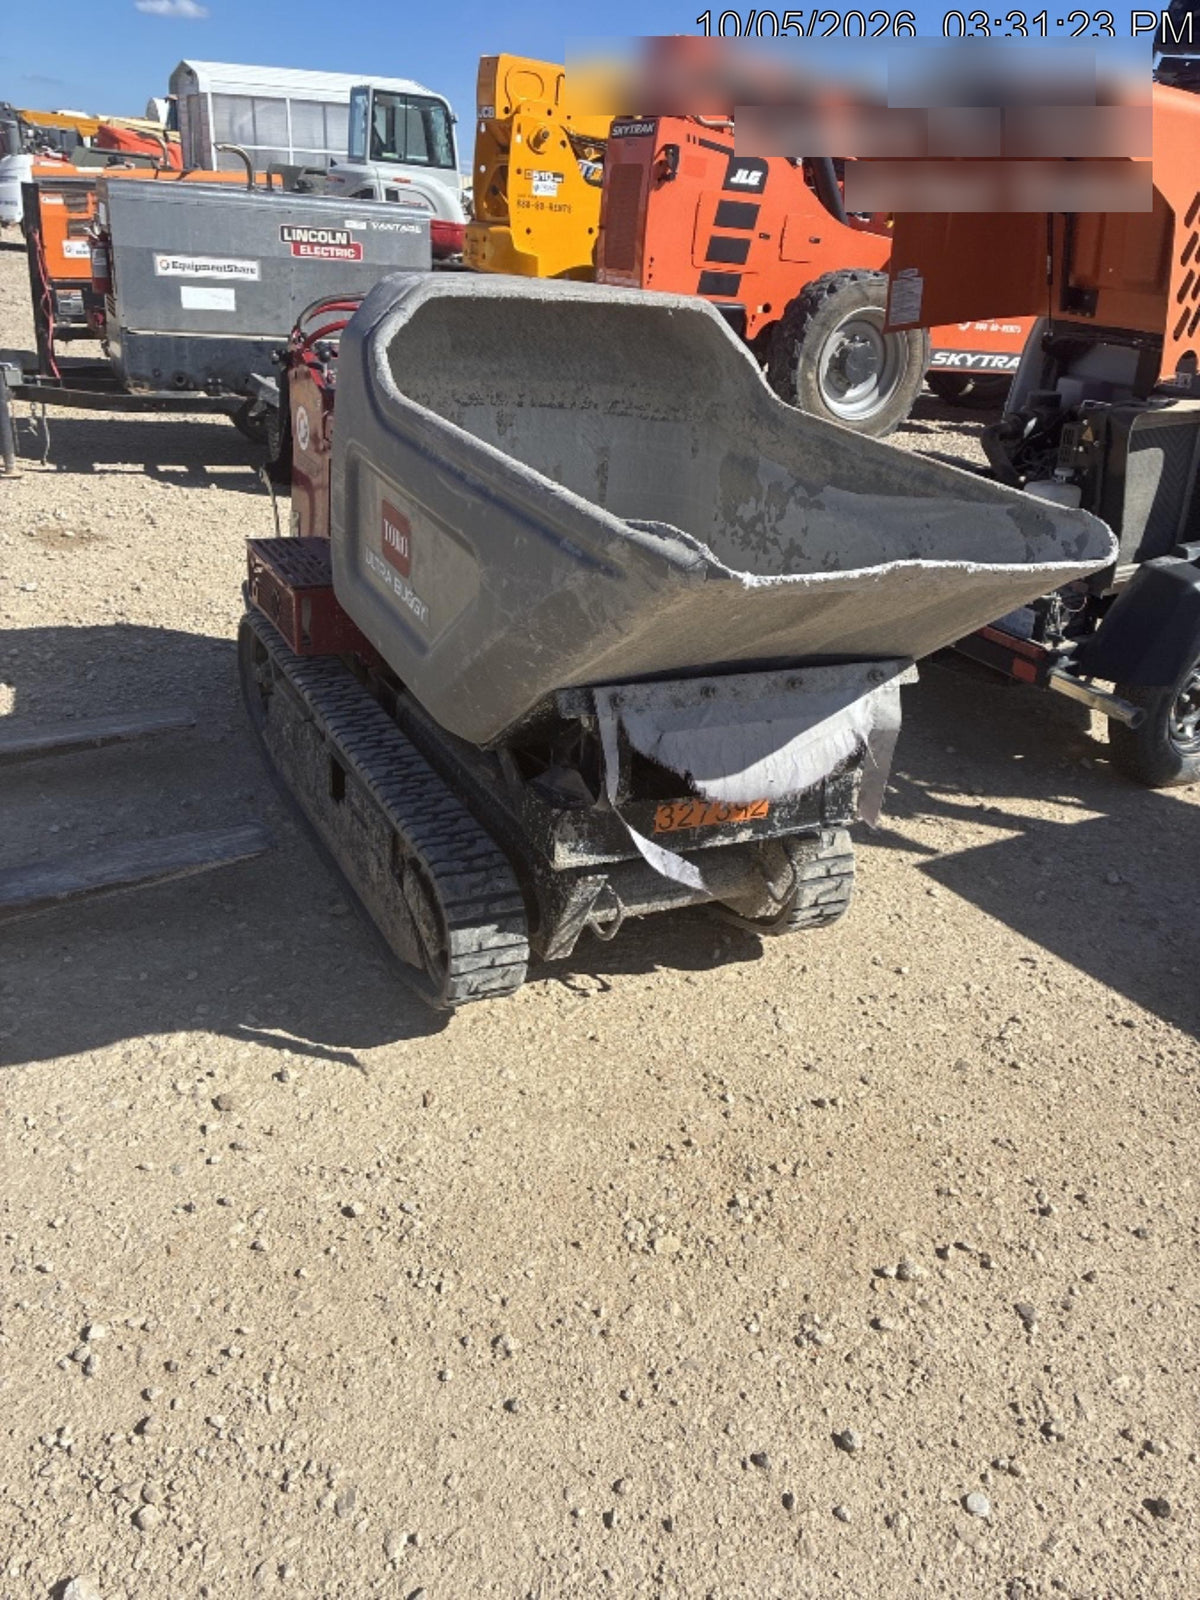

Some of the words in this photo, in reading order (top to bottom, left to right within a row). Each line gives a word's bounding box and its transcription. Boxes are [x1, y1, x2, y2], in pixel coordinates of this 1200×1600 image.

[611, 122, 655, 137] SKYTRAK
[730, 168, 763, 186] JLG
[283, 227, 348, 245] LINCOLN
[299, 245, 356, 259] ELECTRIC
[171, 260, 257, 275] EquipmentShare
